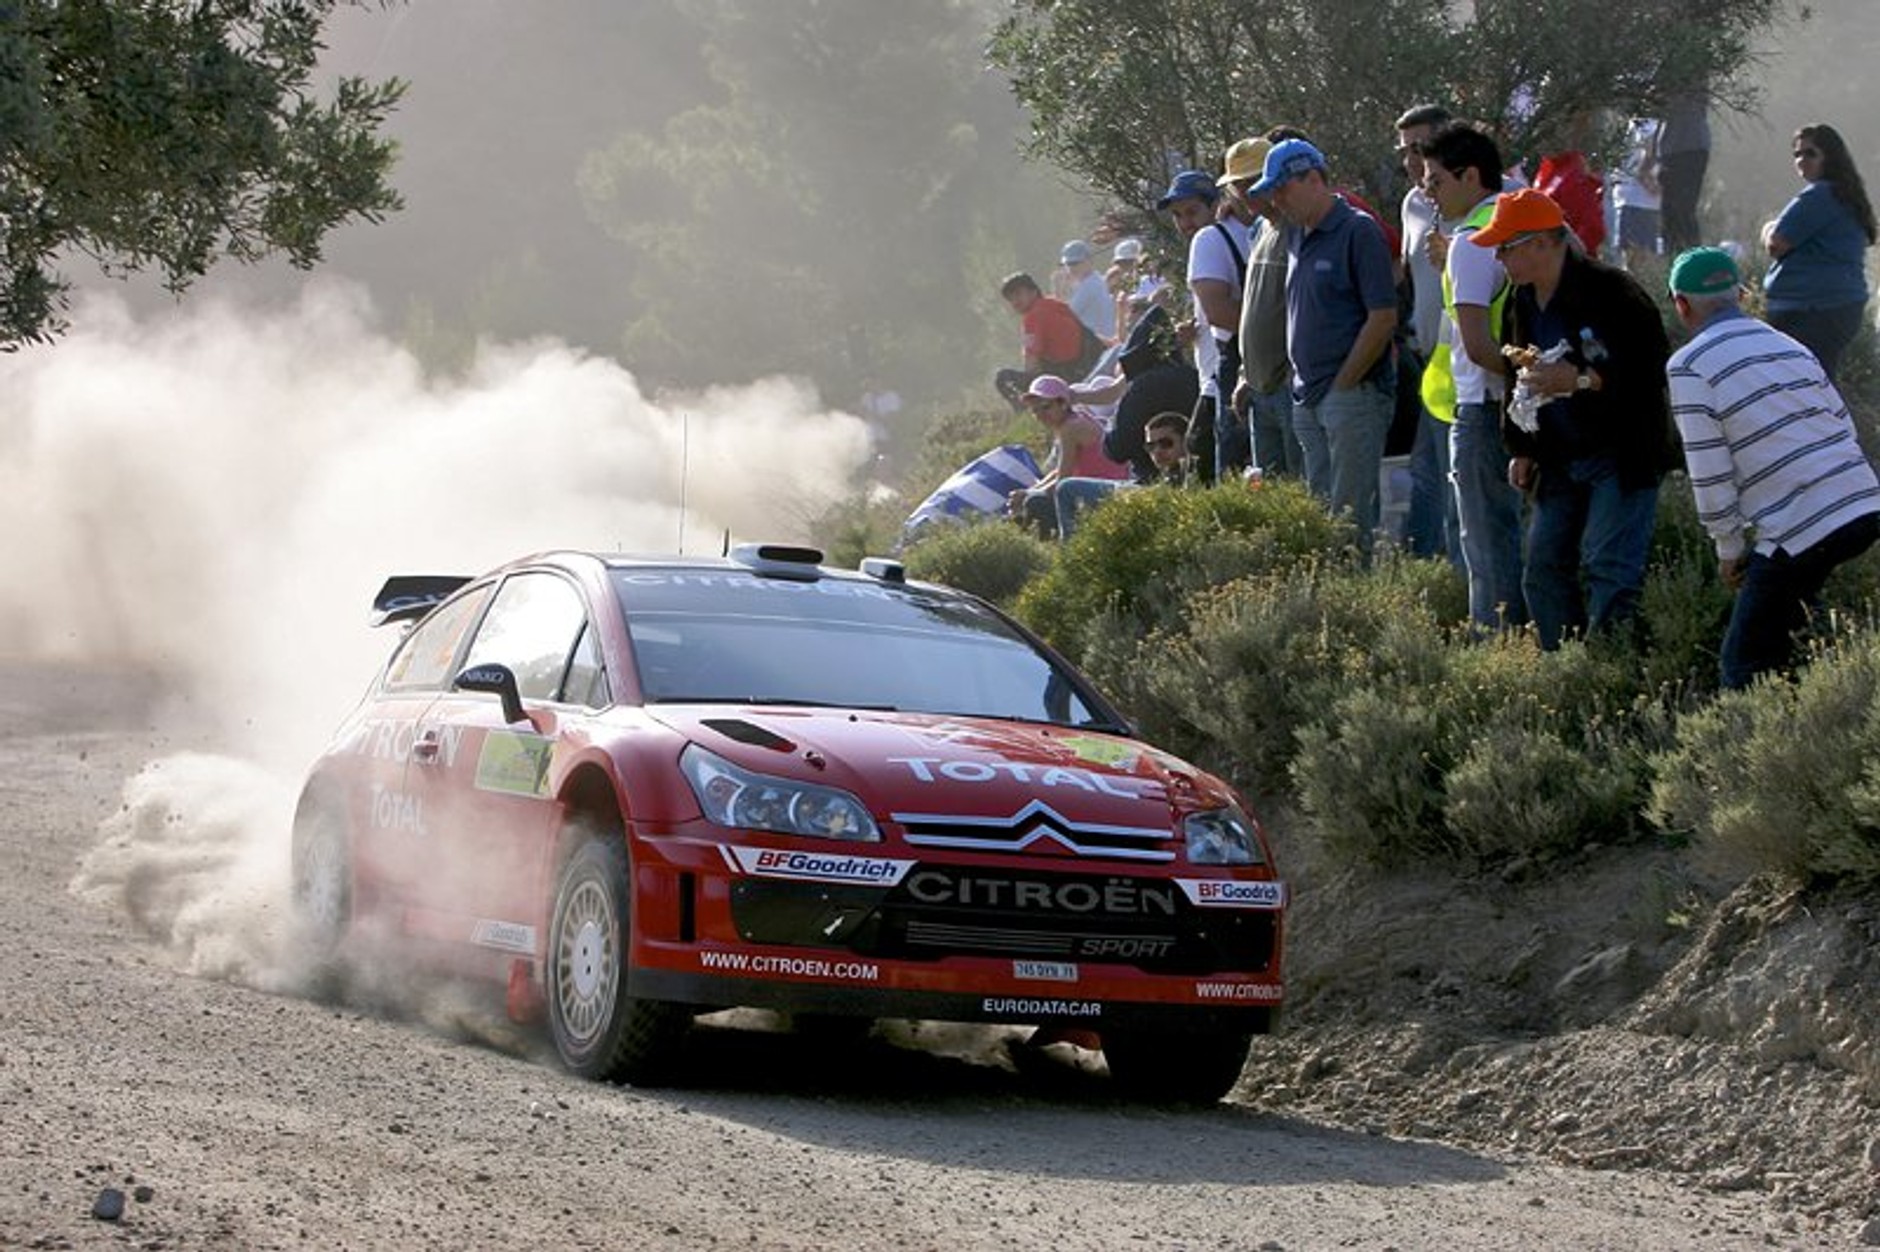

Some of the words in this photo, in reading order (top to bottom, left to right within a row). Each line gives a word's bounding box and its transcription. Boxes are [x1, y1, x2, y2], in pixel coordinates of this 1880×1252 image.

[886, 757, 1139, 799] TOTAL
[371, 783, 429, 835] TOTAL
[757, 851, 898, 877] BFGoodrich
[906, 871, 1177, 916] CITROËN
[1080, 937, 1177, 958] SPORT
[700, 951, 879, 980] WWW.CITROEN.COM
[982, 998, 1102, 1015] EURODATACAR
